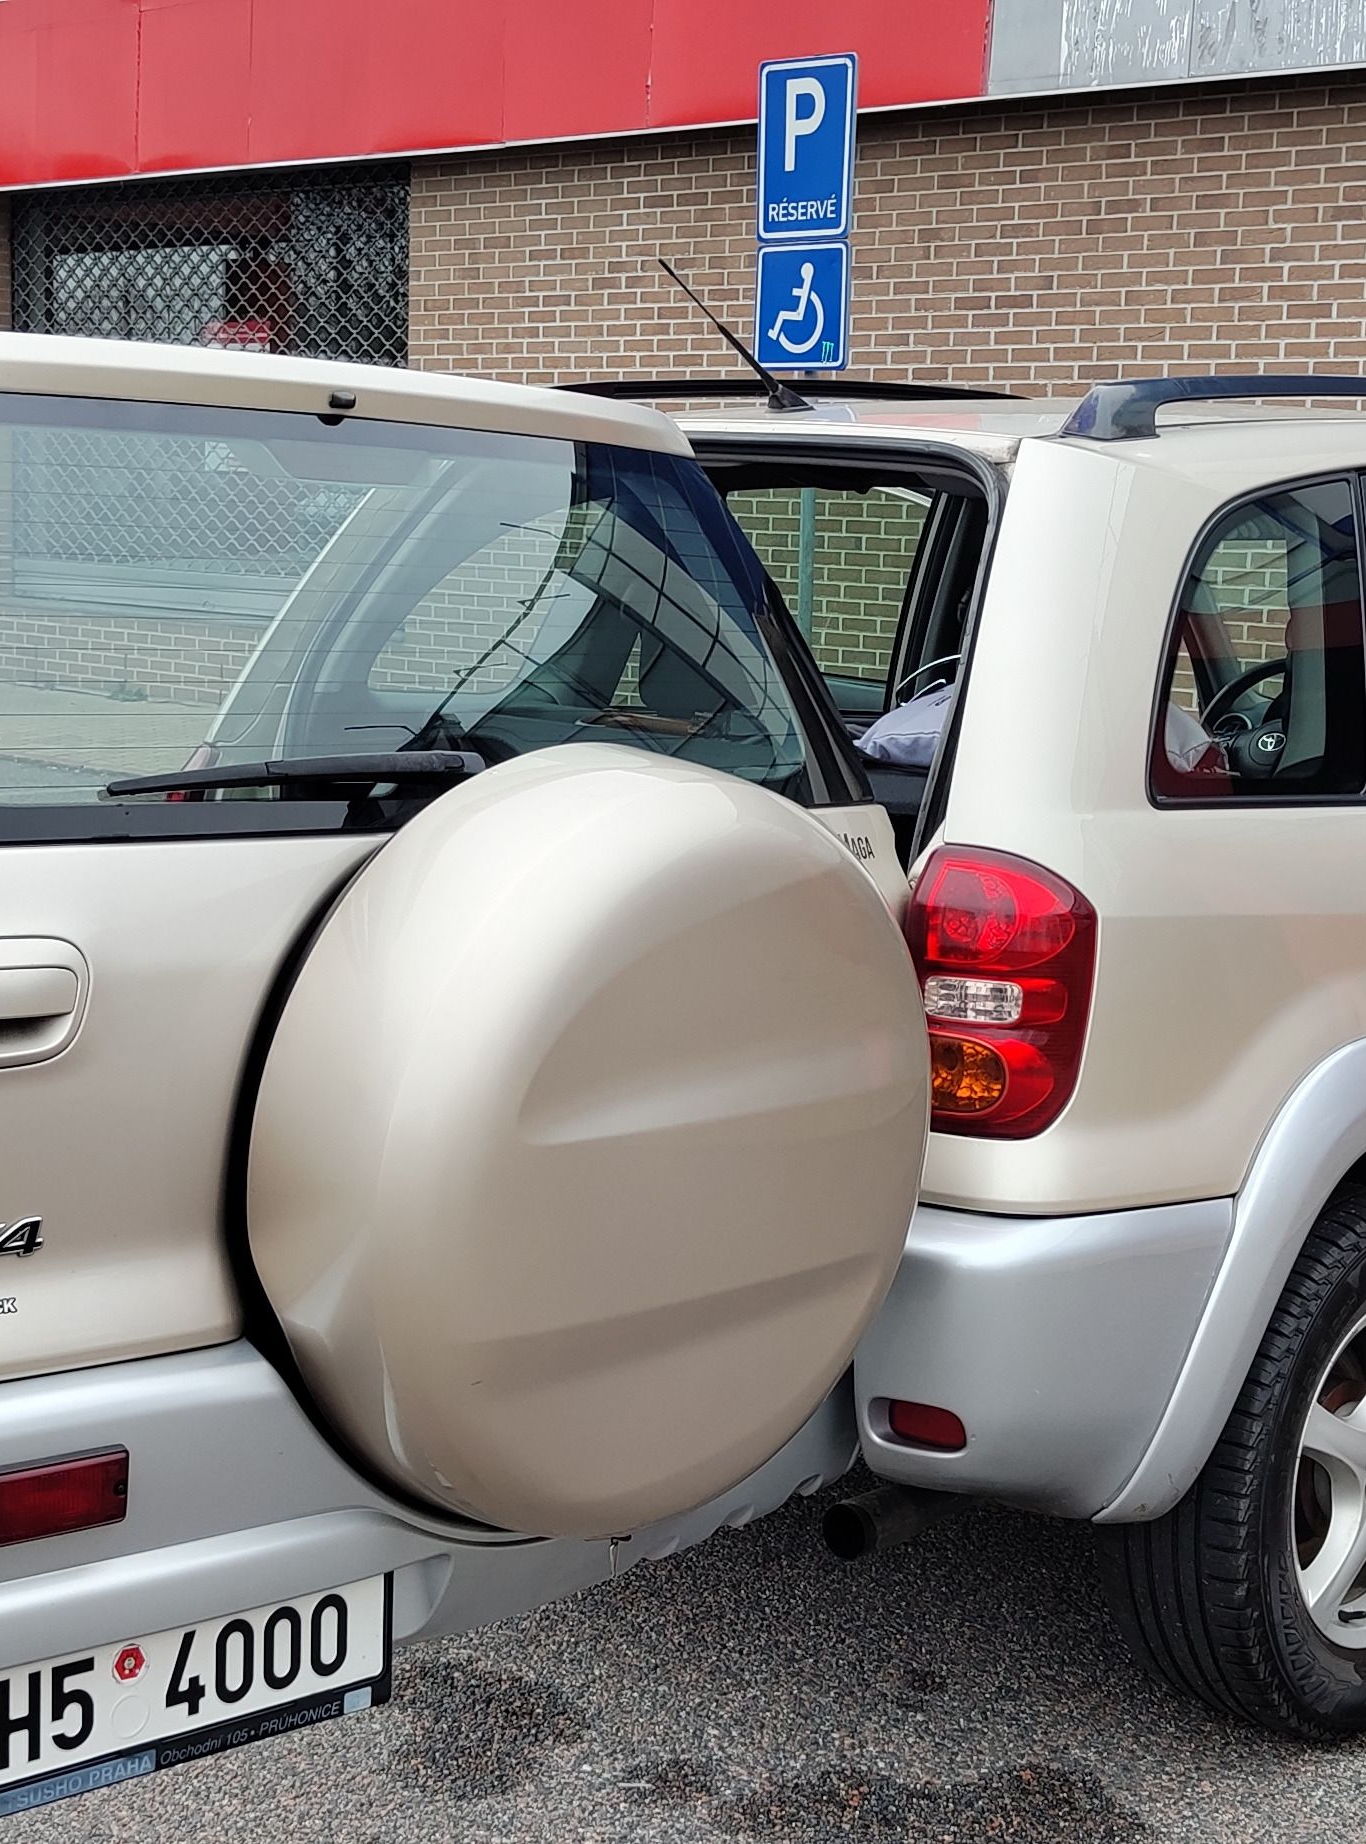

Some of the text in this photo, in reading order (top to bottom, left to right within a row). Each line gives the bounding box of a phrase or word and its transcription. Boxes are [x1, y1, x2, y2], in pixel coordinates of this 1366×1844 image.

[784, 77, 826, 172] P
[768, 194, 837, 222] RÉSERVÉ
[165, 1593, 348, 1717] 4000
[88, 1755, 153, 1787] PRAHA
[160, 1736, 222, 1766] Obchodní
[226, 1730, 249, 1746] 105
